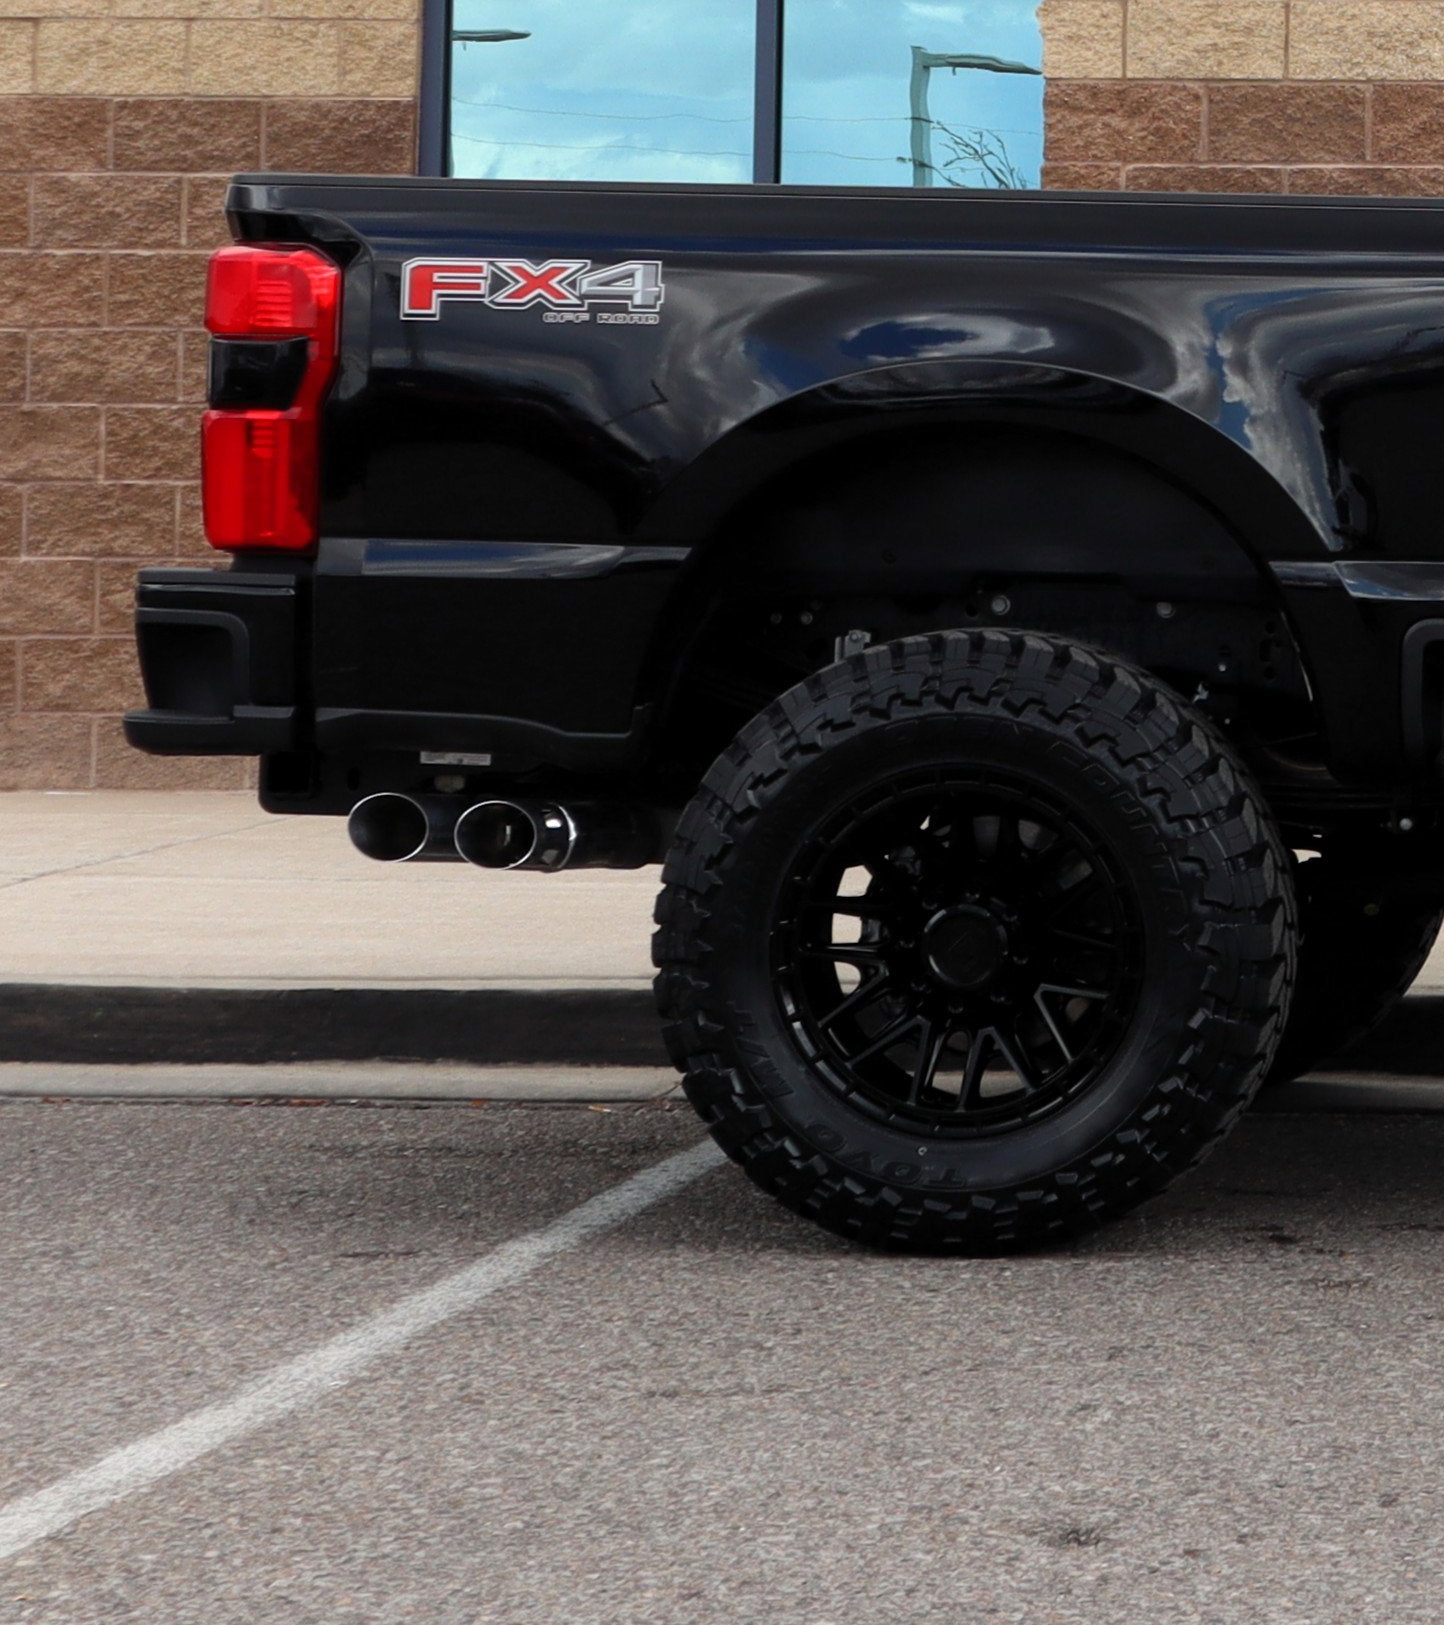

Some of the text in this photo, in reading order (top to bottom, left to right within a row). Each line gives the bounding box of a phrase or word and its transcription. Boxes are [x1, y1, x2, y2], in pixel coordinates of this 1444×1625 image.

[399, 256, 665, 321] FX4
[543, 312, 660, 325] OFF ROAD
[804, 1121, 966, 1189] TOYO
